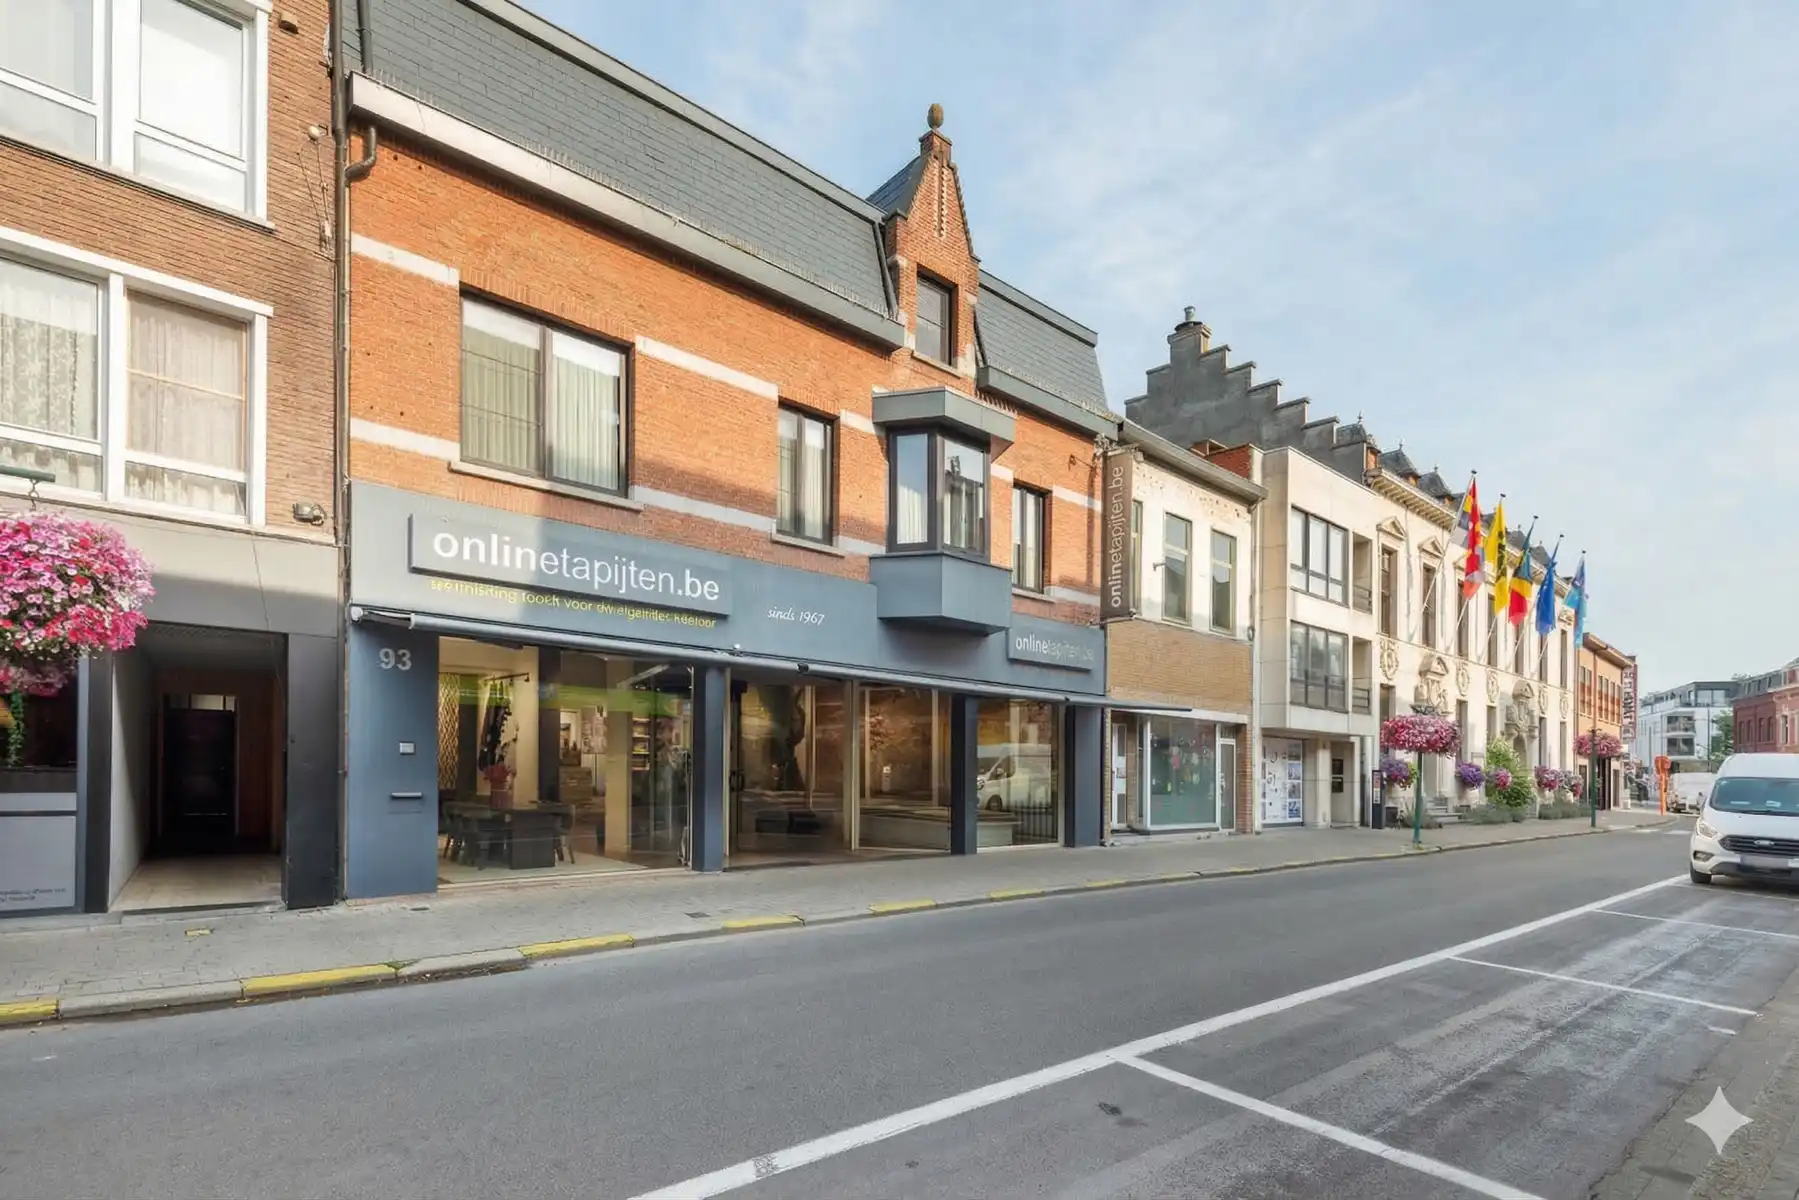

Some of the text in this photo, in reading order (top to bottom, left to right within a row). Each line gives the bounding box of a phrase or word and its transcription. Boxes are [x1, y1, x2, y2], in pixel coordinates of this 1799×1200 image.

[1108, 466, 1126, 607] onlinetapijten.be
[433, 532, 719, 600] onlinetapijten.be
[564, 599, 592, 612] voor
[767, 606, 825, 626] sinds 1967
[379, 648, 412, 671] 93
